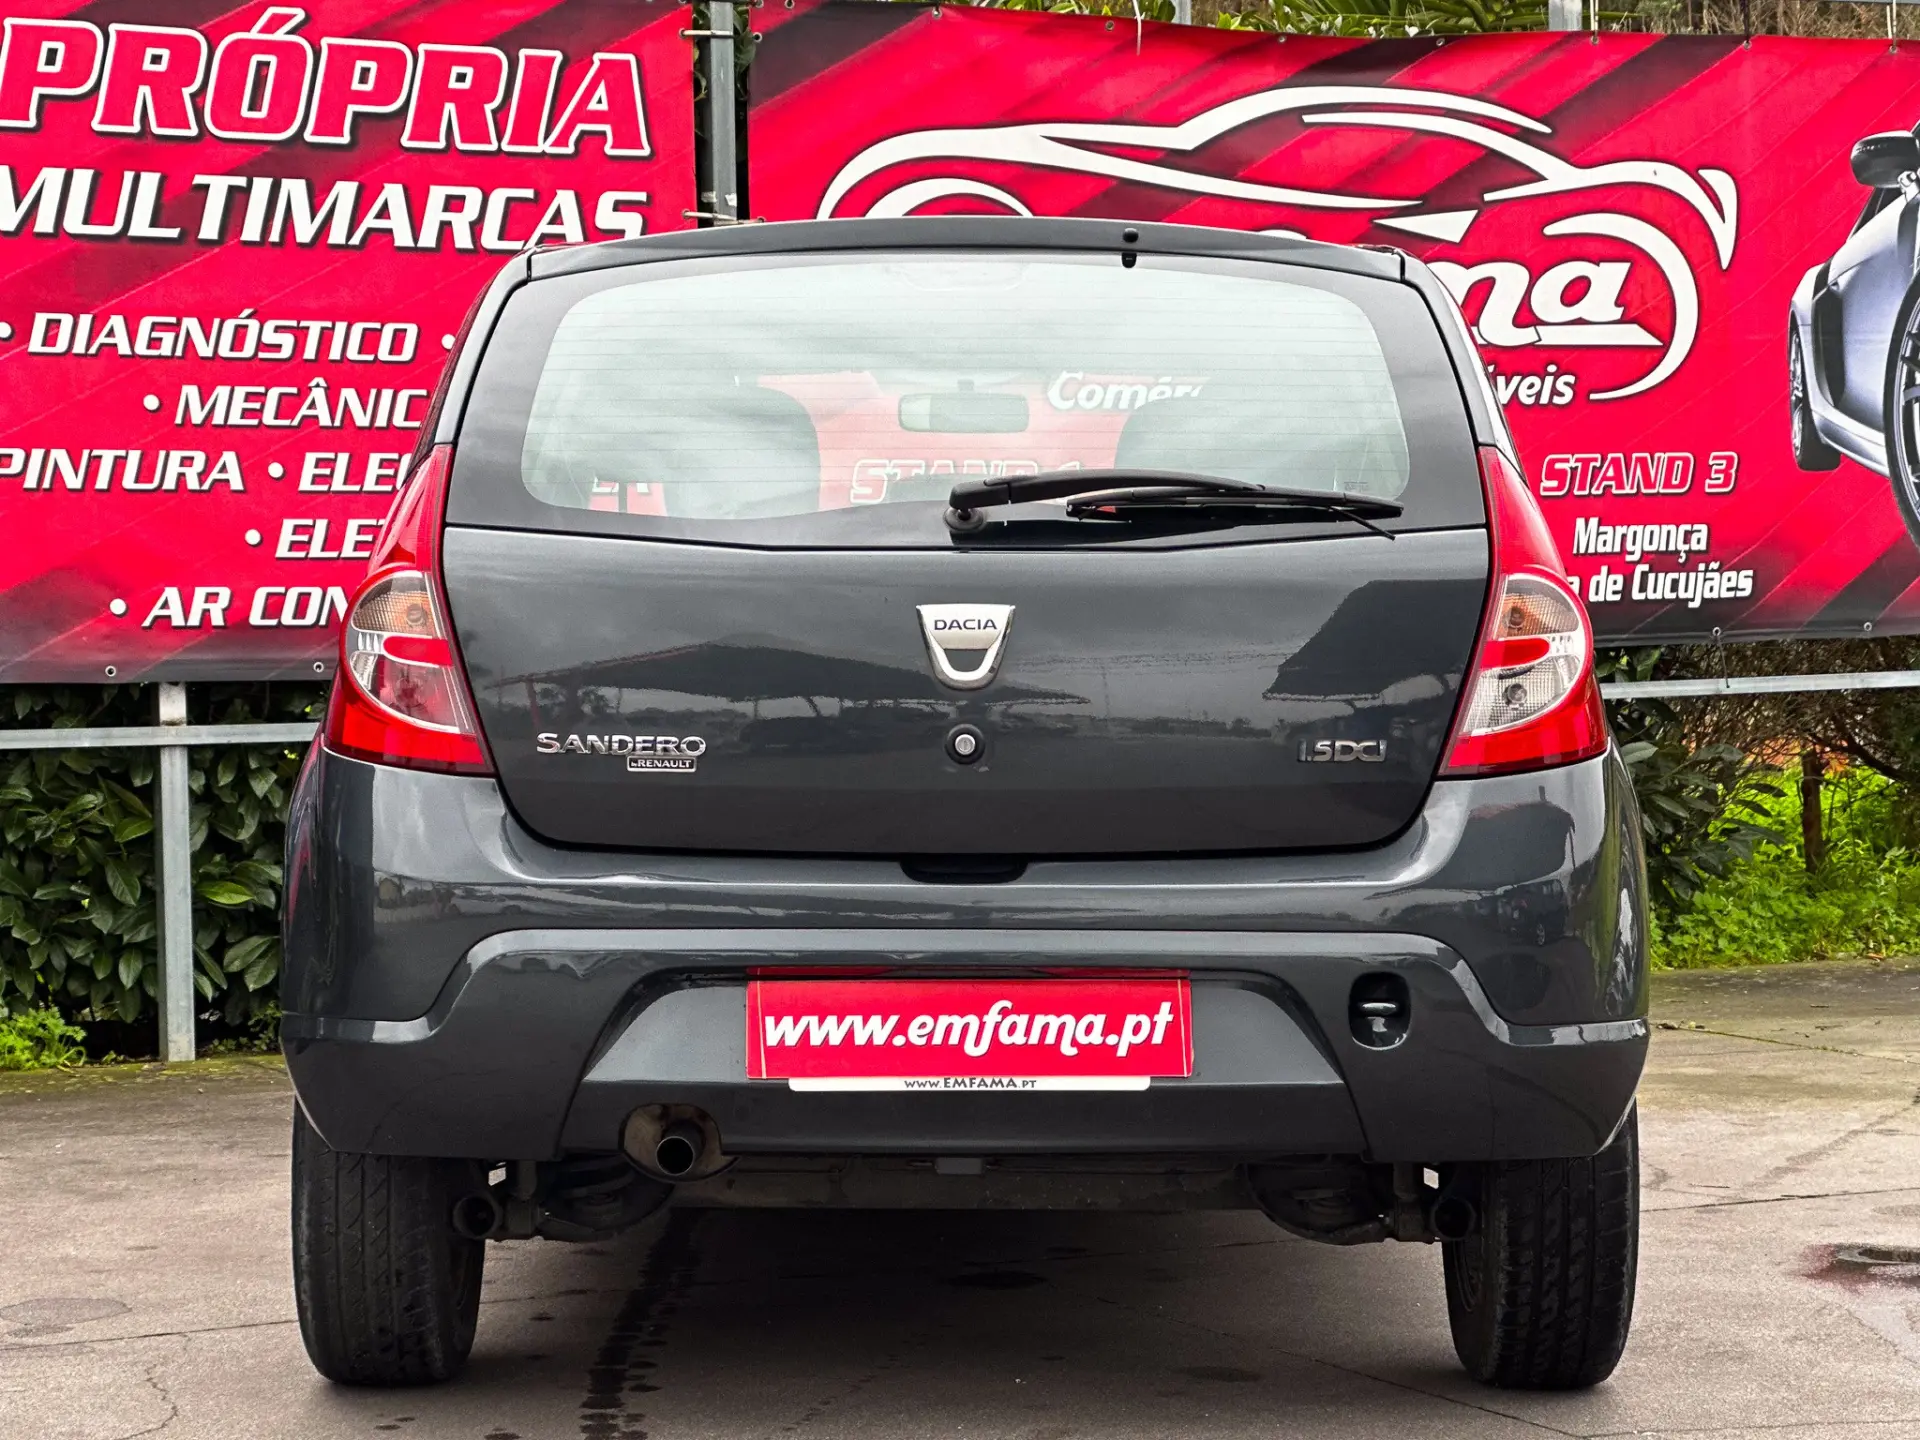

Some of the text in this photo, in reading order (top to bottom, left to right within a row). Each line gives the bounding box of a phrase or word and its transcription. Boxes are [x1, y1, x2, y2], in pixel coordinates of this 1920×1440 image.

[1, 6, 651, 157] PRÓPRIA
[0, 164, 647, 250] MULTIMARCAS
[27, 310, 418, 362] DIAGNÓSTICO
[175, 378, 427, 428] MECÂNIC
[1487, 364, 1575, 406] veis
[1540, 451, 1738, 496] STAND 3
[275, 518, 385, 558] ELE
[1573, 517, 1708, 563] Margonça
[142, 587, 230, 627] AR
[1588, 565, 1624, 602] de
[1631, 561, 1753, 608] Cucujães
[934, 619, 997, 630] DACIA
[536, 732, 707, 757] SANDERO
[637, 759, 691, 768] RENAULT
[764, 1000, 1173, 1057] www.emfama.pt
